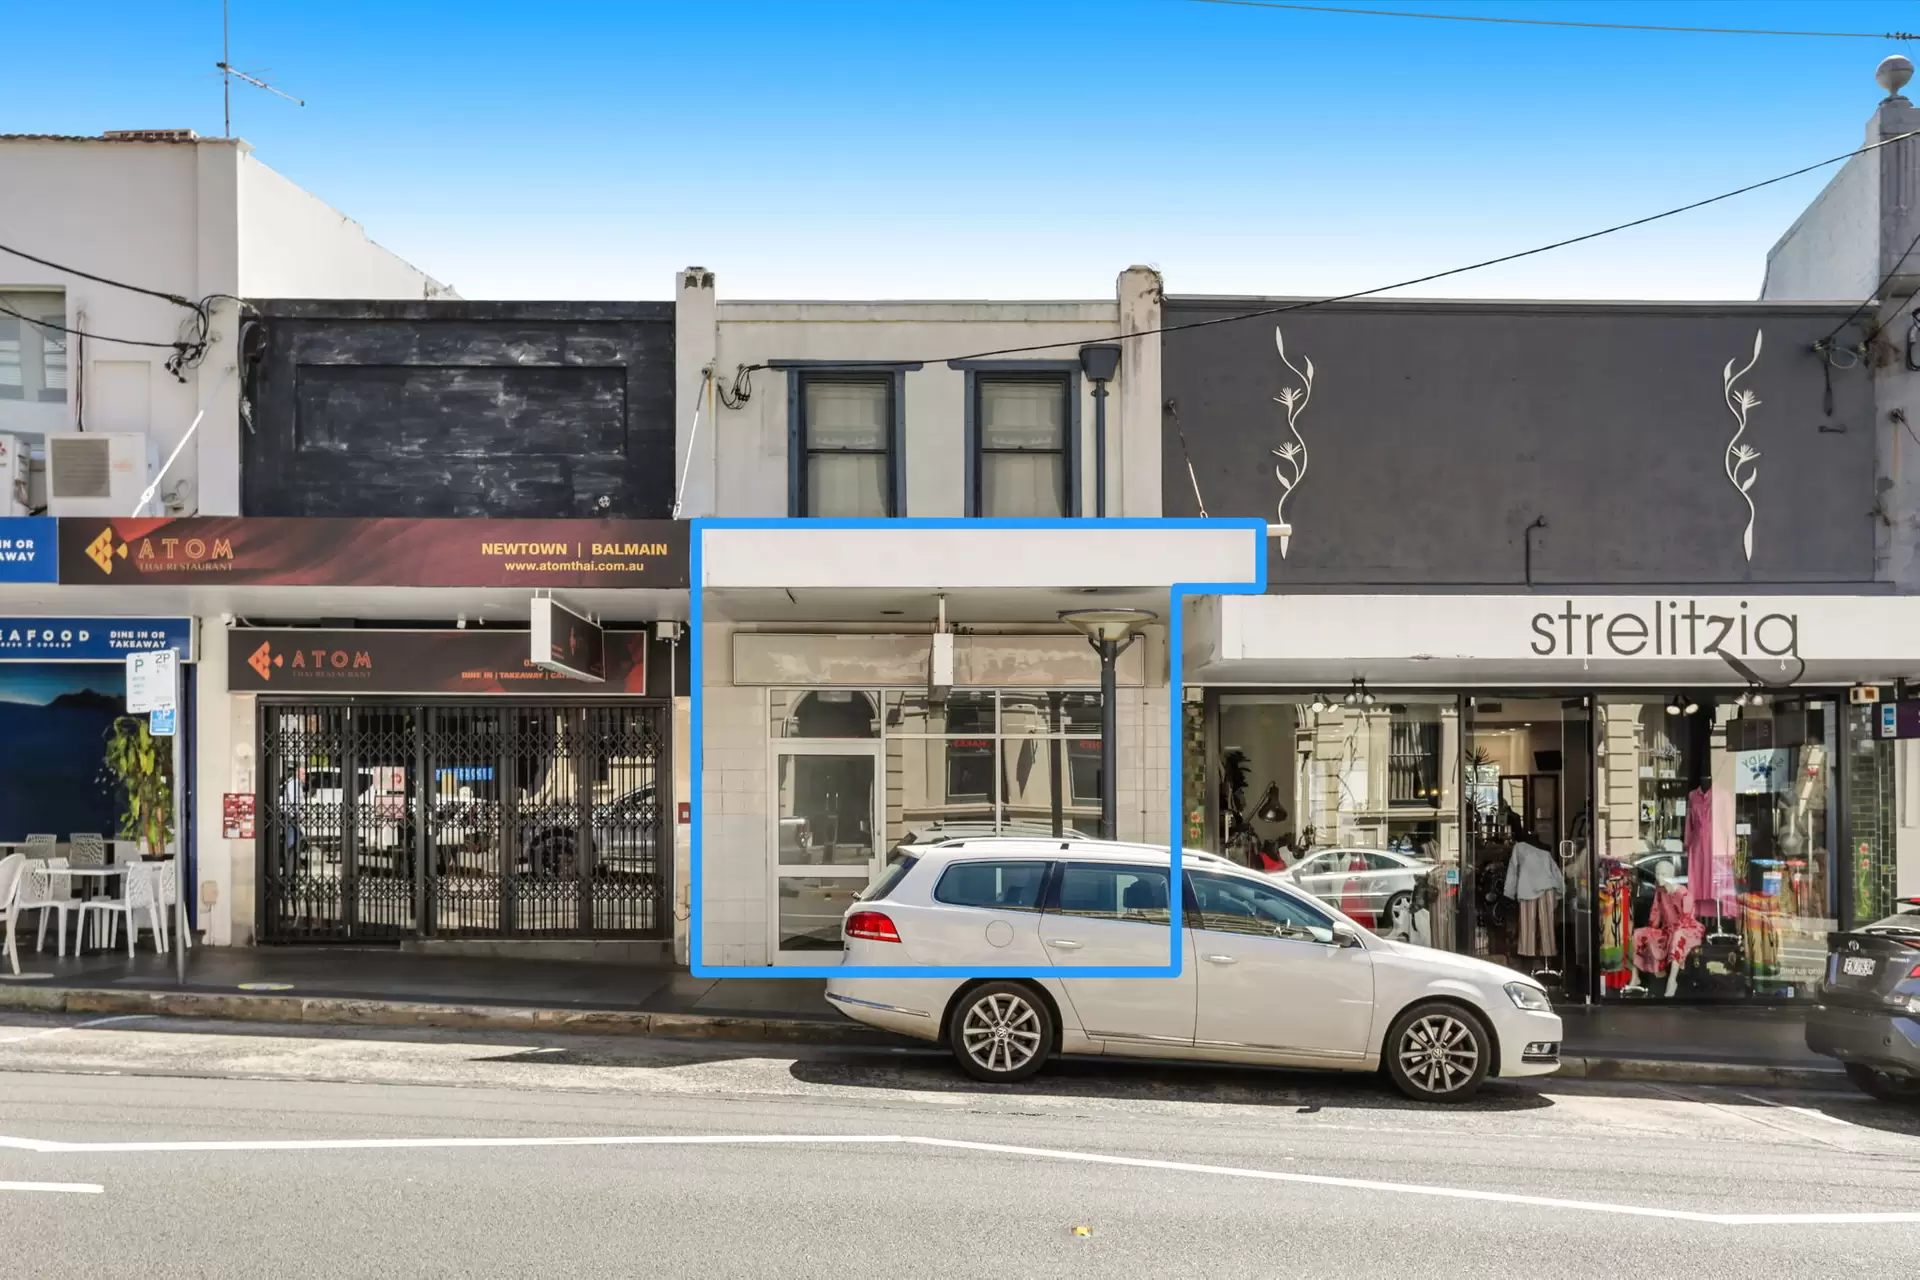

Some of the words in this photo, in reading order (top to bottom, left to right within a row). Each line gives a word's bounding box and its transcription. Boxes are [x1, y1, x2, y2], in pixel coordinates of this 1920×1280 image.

[16, 540, 34, 549] OR
[138, 538, 234, 559] ATOM
[481, 543, 568, 556] NEWTOWN
[591, 543, 668, 556] BALMAIN
[166, 562, 233, 572] RESTAURANT
[504, 561, 645, 571] www.atomthai.com.au
[0, 629, 90, 642] AFOOD
[110, 631, 134, 639] DINE
[137, 631, 148, 639] IN
[151, 631, 165, 639] OR
[109, 640, 166, 649] TAKEAWAY
[1531, 599, 1806, 688] strelitzia
[155, 652, 171, 664] 2P
[291, 650, 372, 668] ATOM
[135, 659, 144, 673] P
[461, 671, 481, 679] DINE
[484, 671, 493, 679] IN
[500, 671, 543, 679] TAKEAWAY
